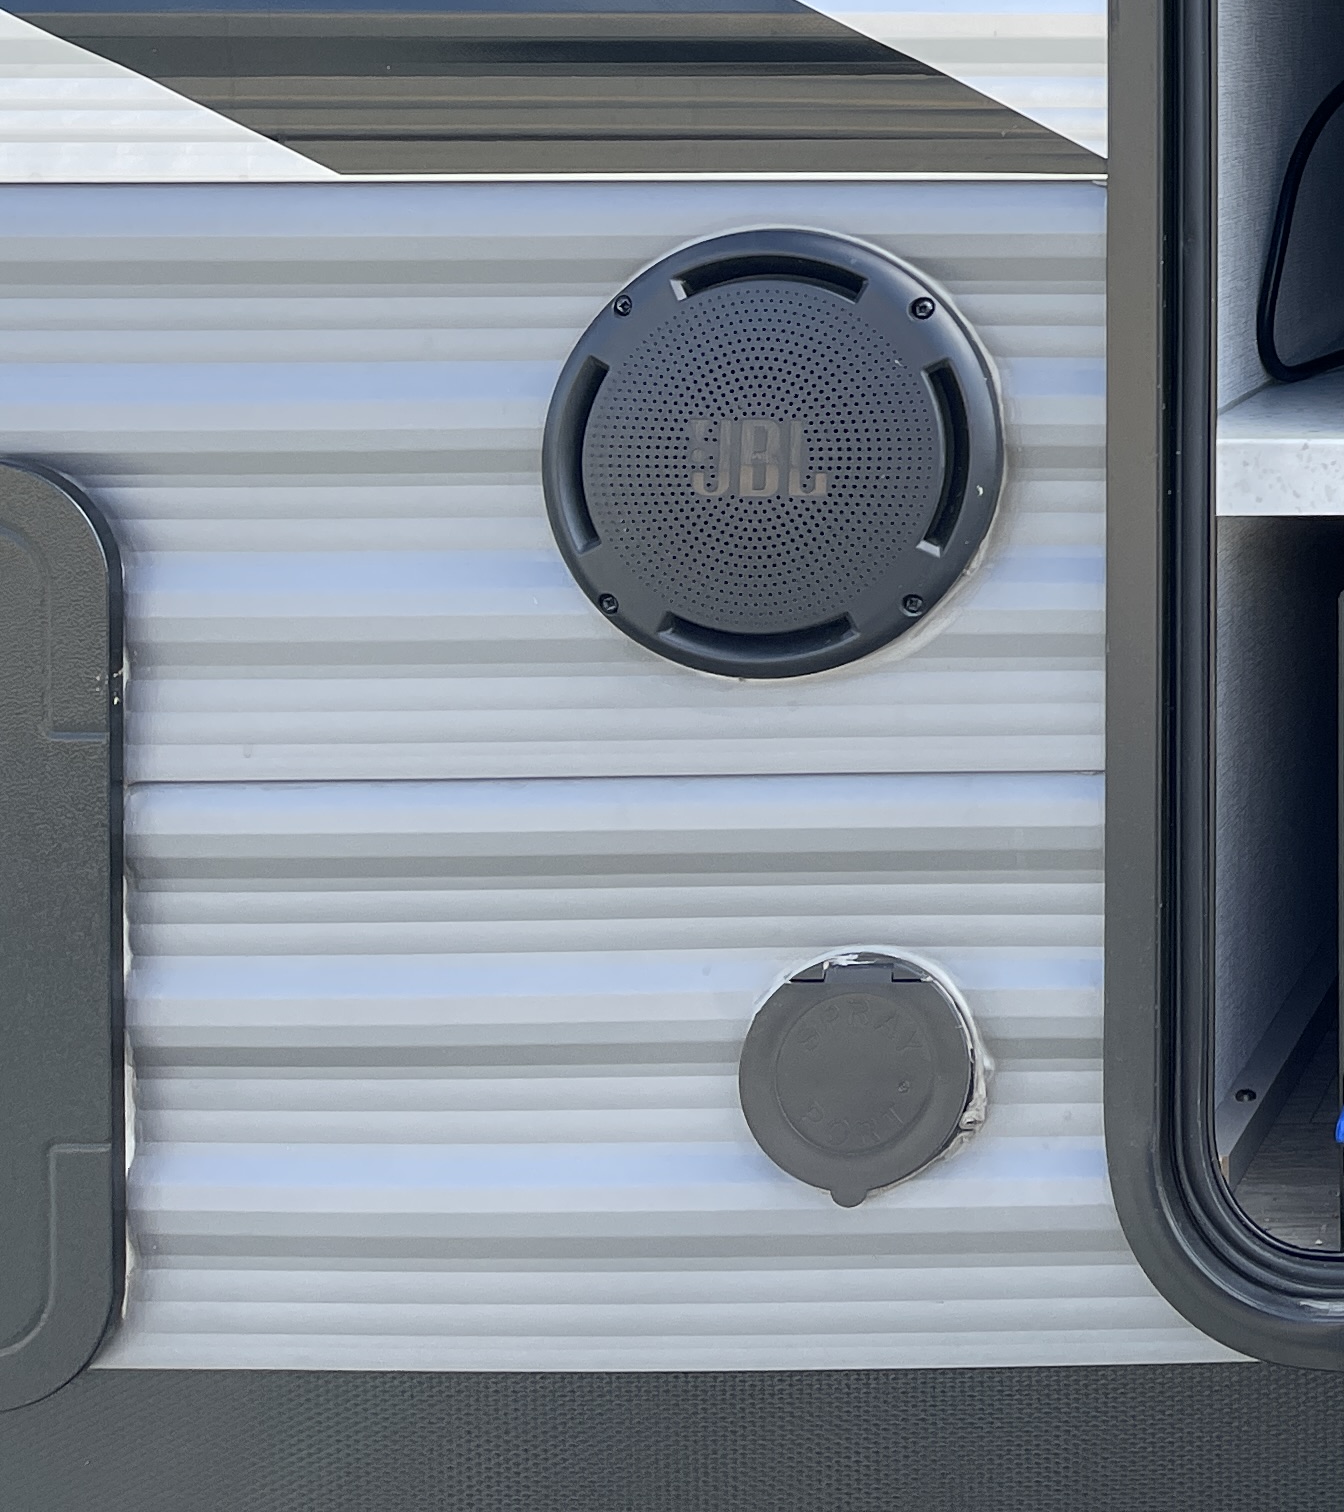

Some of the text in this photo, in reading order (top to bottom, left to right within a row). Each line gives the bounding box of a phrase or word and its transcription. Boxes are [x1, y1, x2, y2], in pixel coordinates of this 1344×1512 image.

[690, 418, 828, 498] JBL
[798, 998, 924, 1053] SPRAY
[801, 1100, 905, 1147] PORT
